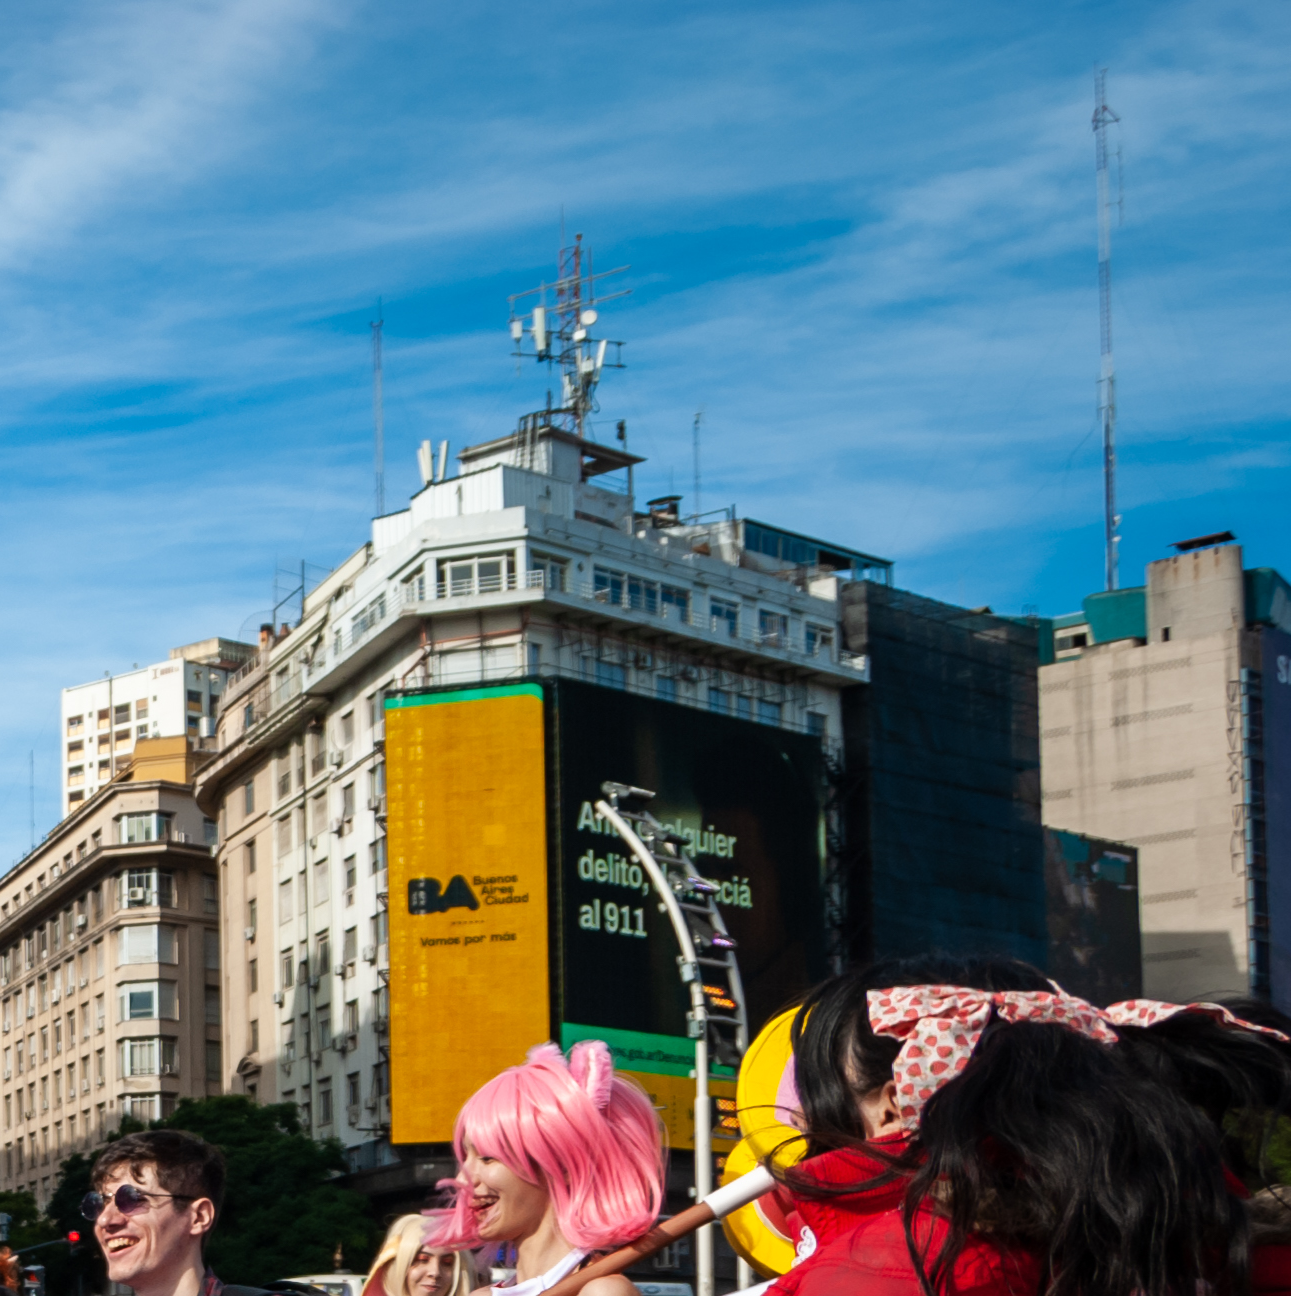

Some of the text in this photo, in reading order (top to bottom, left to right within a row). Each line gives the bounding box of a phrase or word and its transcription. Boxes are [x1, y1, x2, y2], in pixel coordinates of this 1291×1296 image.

[473, 875, 518, 886] Buenos
[406, 874, 480, 915] BA
[481, 885, 514, 896] Aires
[485, 893, 529, 905] Ciudad
[579, 899, 647, 937] al 911
[420, 931, 517, 947] Vamos por más
